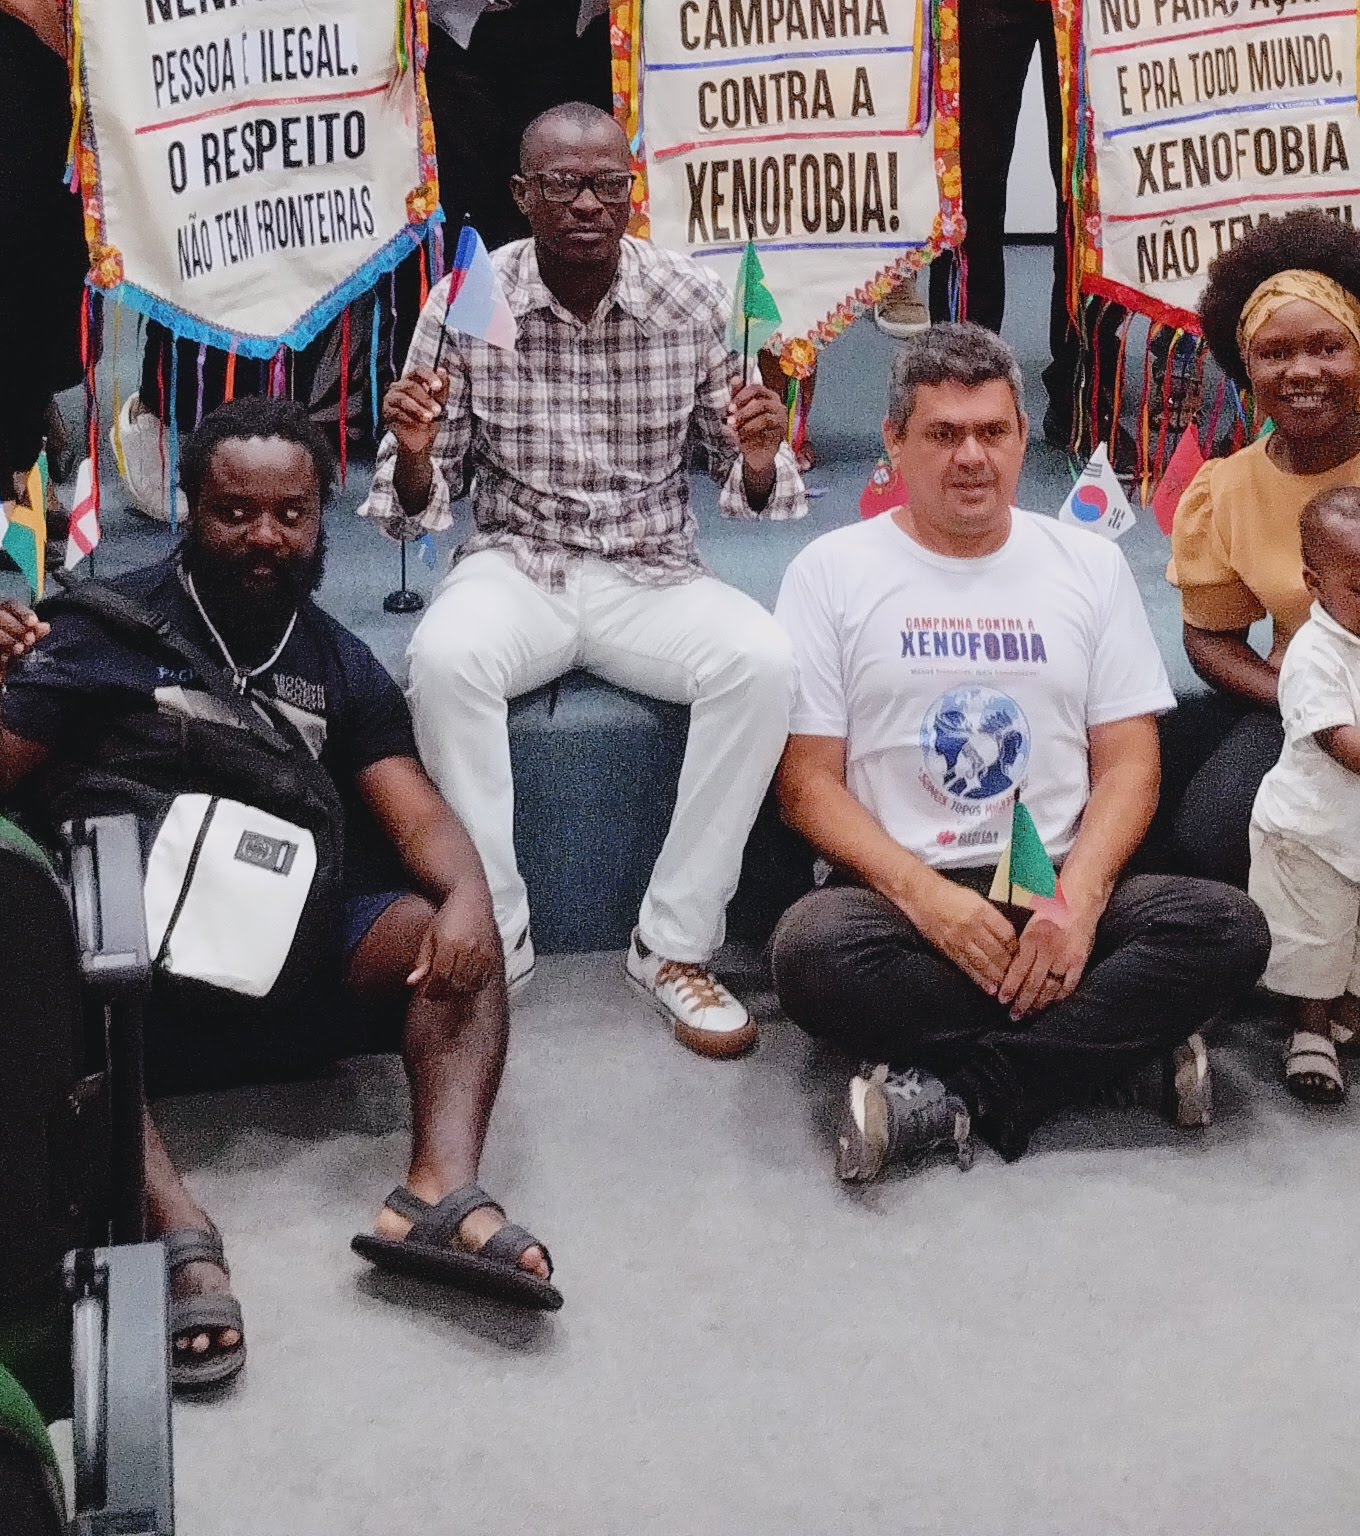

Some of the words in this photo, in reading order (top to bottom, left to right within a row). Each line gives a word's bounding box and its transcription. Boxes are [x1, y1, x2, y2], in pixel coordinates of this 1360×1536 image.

[152, 36, 237, 109] PESSOA
[260, 23, 359, 84] ILEGAL.
[698, 66, 836, 131] CONTRA
[851, 66, 876, 118] A
[1138, 57, 1183, 113] PRA
[1188, 45, 1240, 103] TODO
[1246, 32, 1343, 93] MUNDO,
[167, 140, 187, 195] O
[202, 110, 367, 188] RESPEITO
[1132, 121, 1350, 197] XENOFOBIA
[176, 211, 213, 281] NÃO
[216, 204, 254, 264] TEM
[255, 185, 376, 255] FRONTEIRAS
[684, 151, 901, 244] XENOFOBIA!
[1137, 220, 1200, 284] NÃO
[900, 630, 1048, 664] XENOFOBIA
